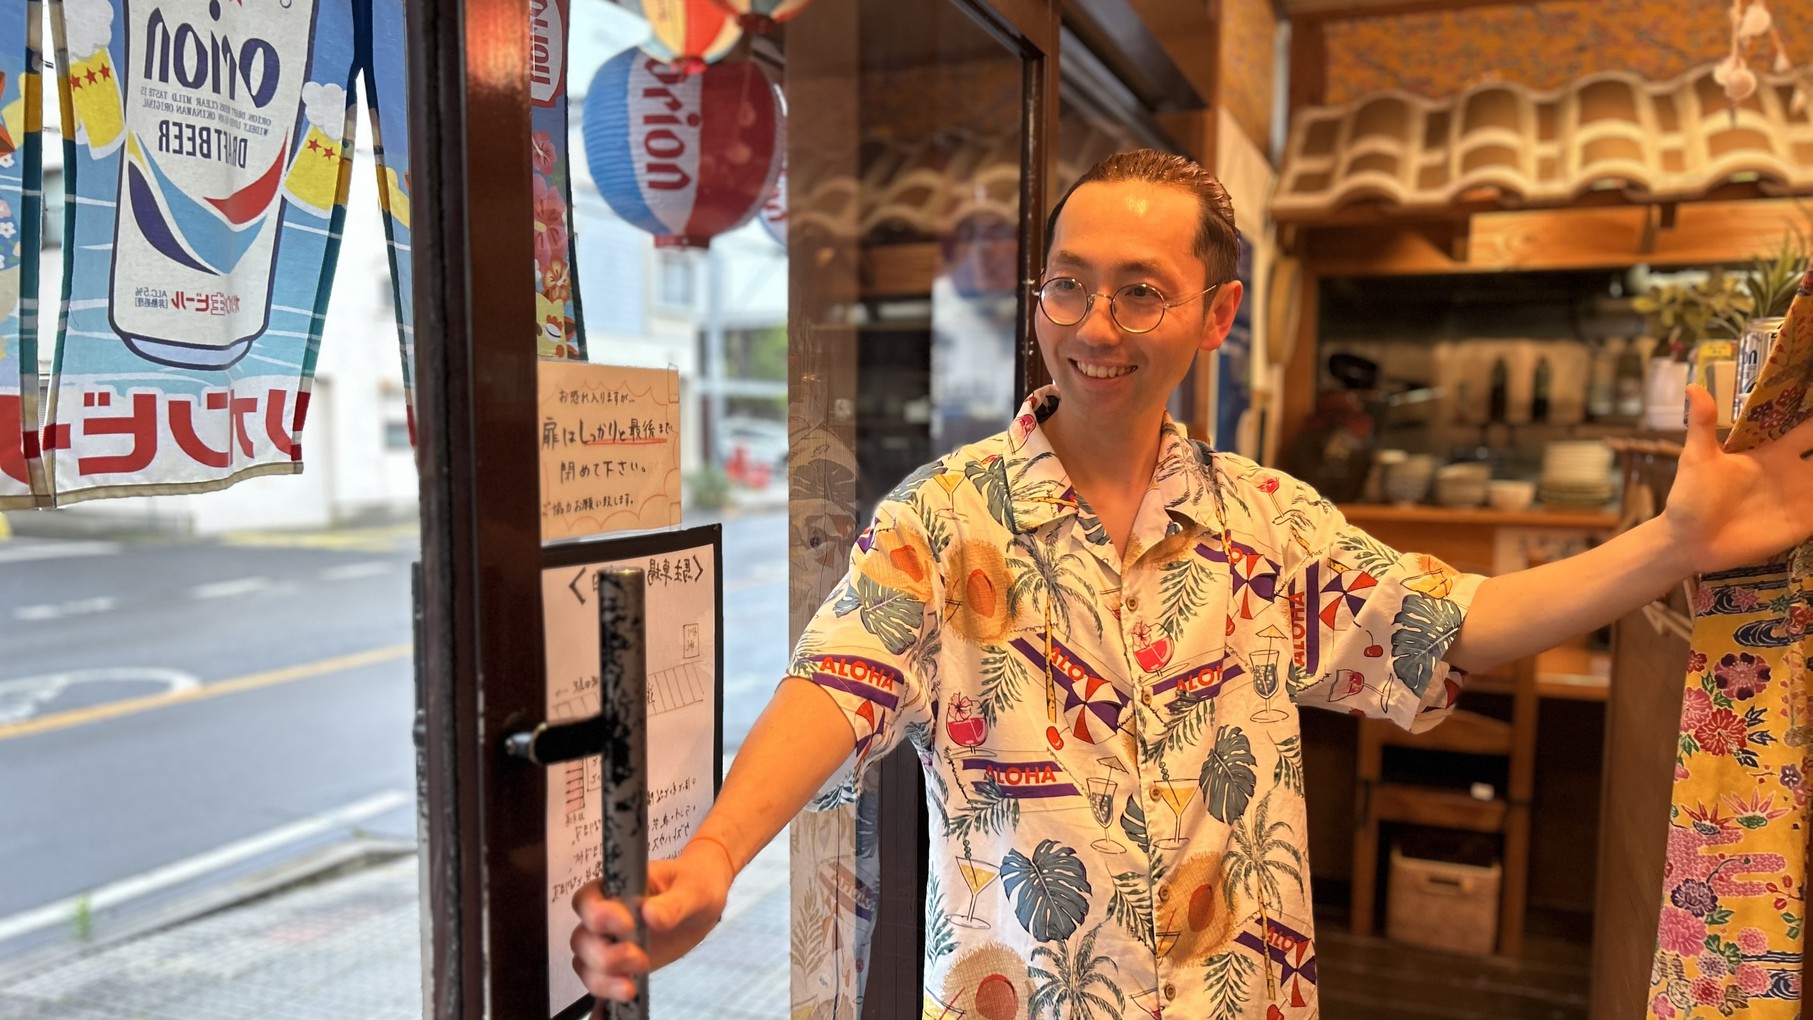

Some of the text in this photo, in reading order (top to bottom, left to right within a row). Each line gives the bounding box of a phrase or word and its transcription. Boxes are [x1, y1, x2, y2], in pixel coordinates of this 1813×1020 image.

[1289, 591, 1306, 668] ALOHA
[819, 656, 896, 691] ALOHA
[984, 764, 1057, 786] ALOHA
